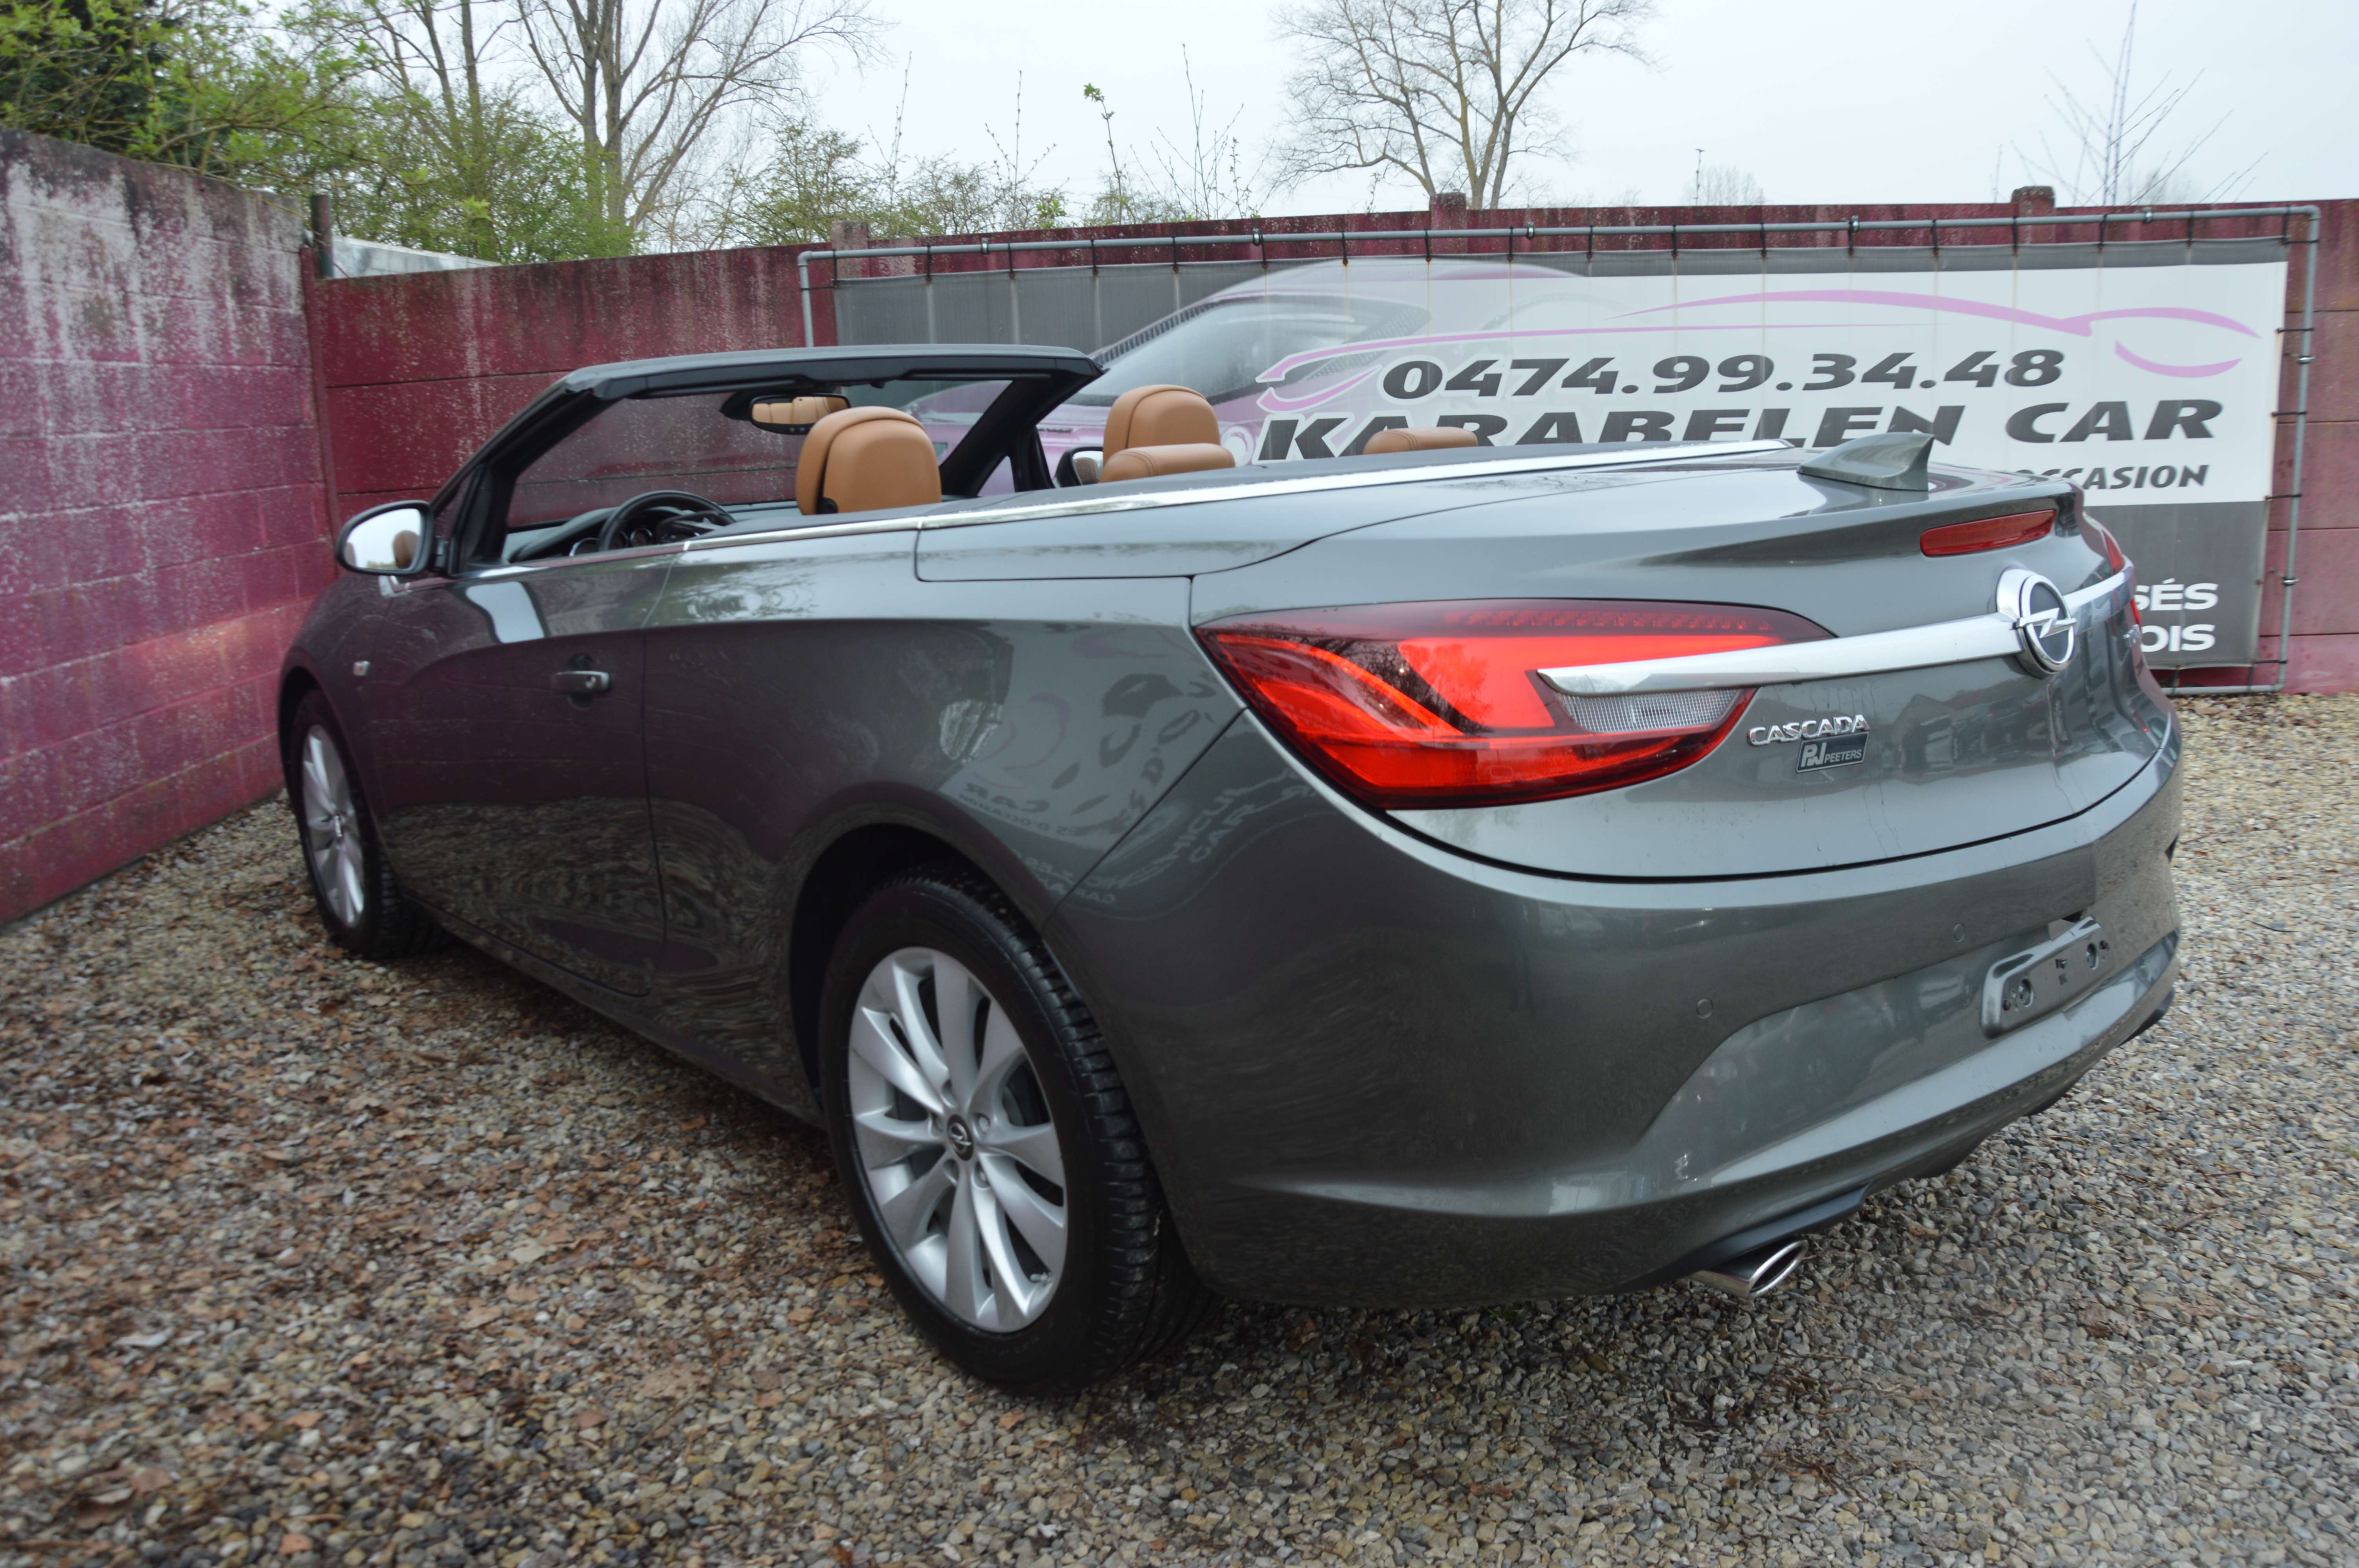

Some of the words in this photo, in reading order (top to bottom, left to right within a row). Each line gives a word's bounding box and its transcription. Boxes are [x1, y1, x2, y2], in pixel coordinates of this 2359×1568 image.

[1383, 349, 2065, 399] 0474.99.34.48
[2006, 399, 2223, 443] CAR
[1747, 714, 1870, 746] CASCADA
[1825, 749, 1862, 764] PEETERS
